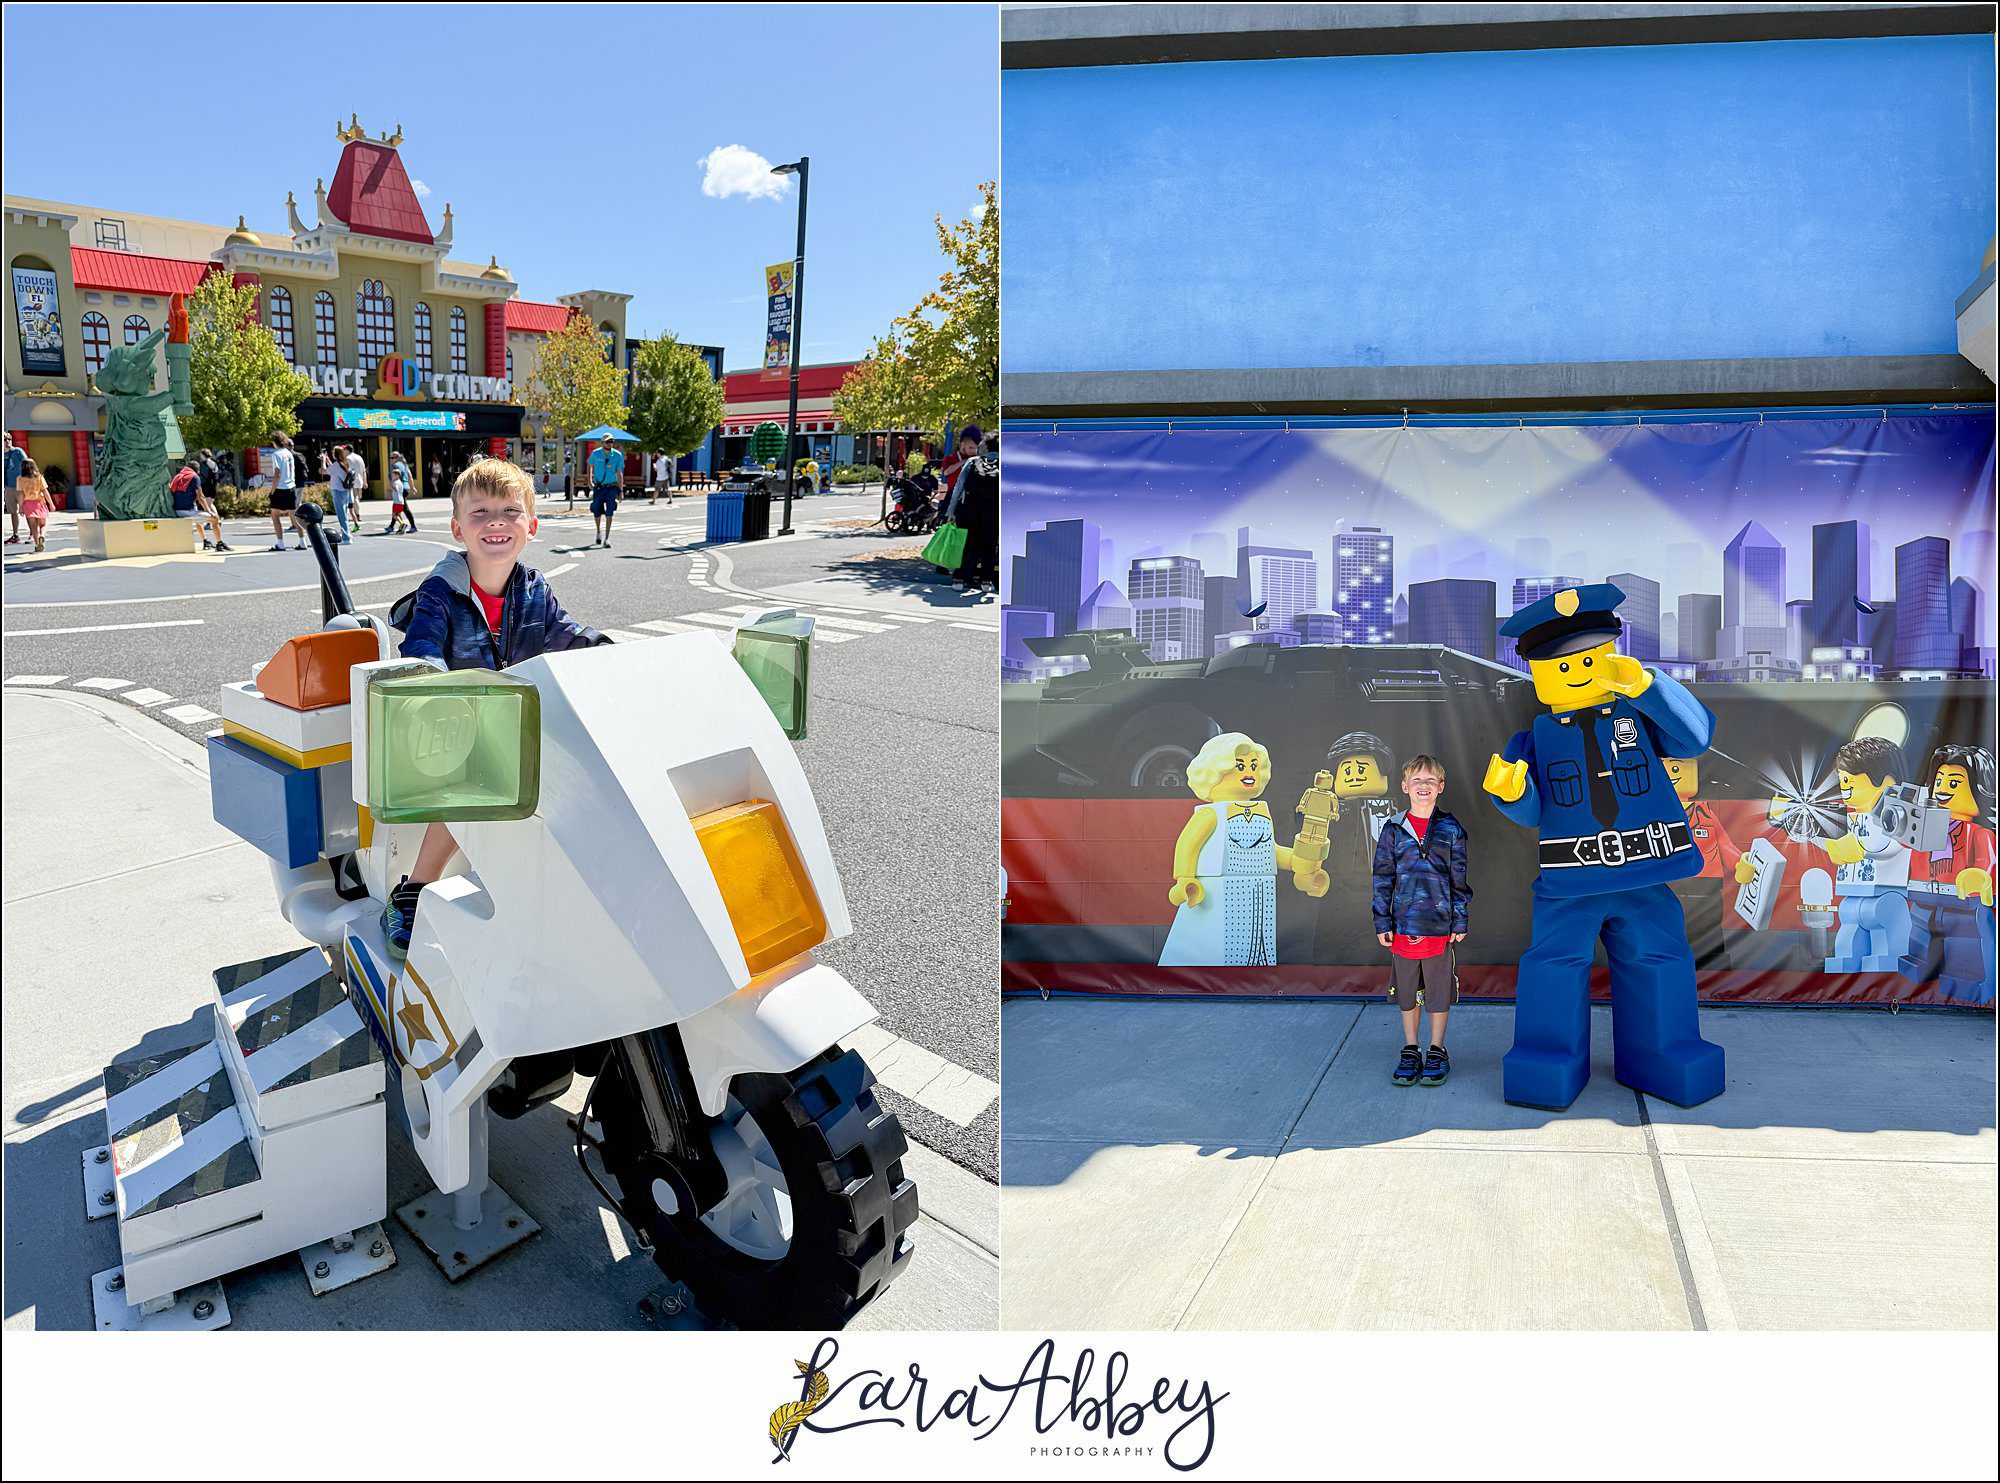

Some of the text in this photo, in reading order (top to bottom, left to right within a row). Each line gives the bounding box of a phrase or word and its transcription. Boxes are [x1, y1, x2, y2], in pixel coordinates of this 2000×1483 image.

[16, 275, 53, 286] TOUCH
[17, 284, 54, 296] DOWN
[774, 296, 786, 304] FIND
[773, 303, 787, 311] YOUR
[769, 308, 791, 318] FAVORITE
[384, 358, 421, 397] 4D
[430, 373, 512, 402] CINEMA
[416, 713, 473, 760] LEGO
